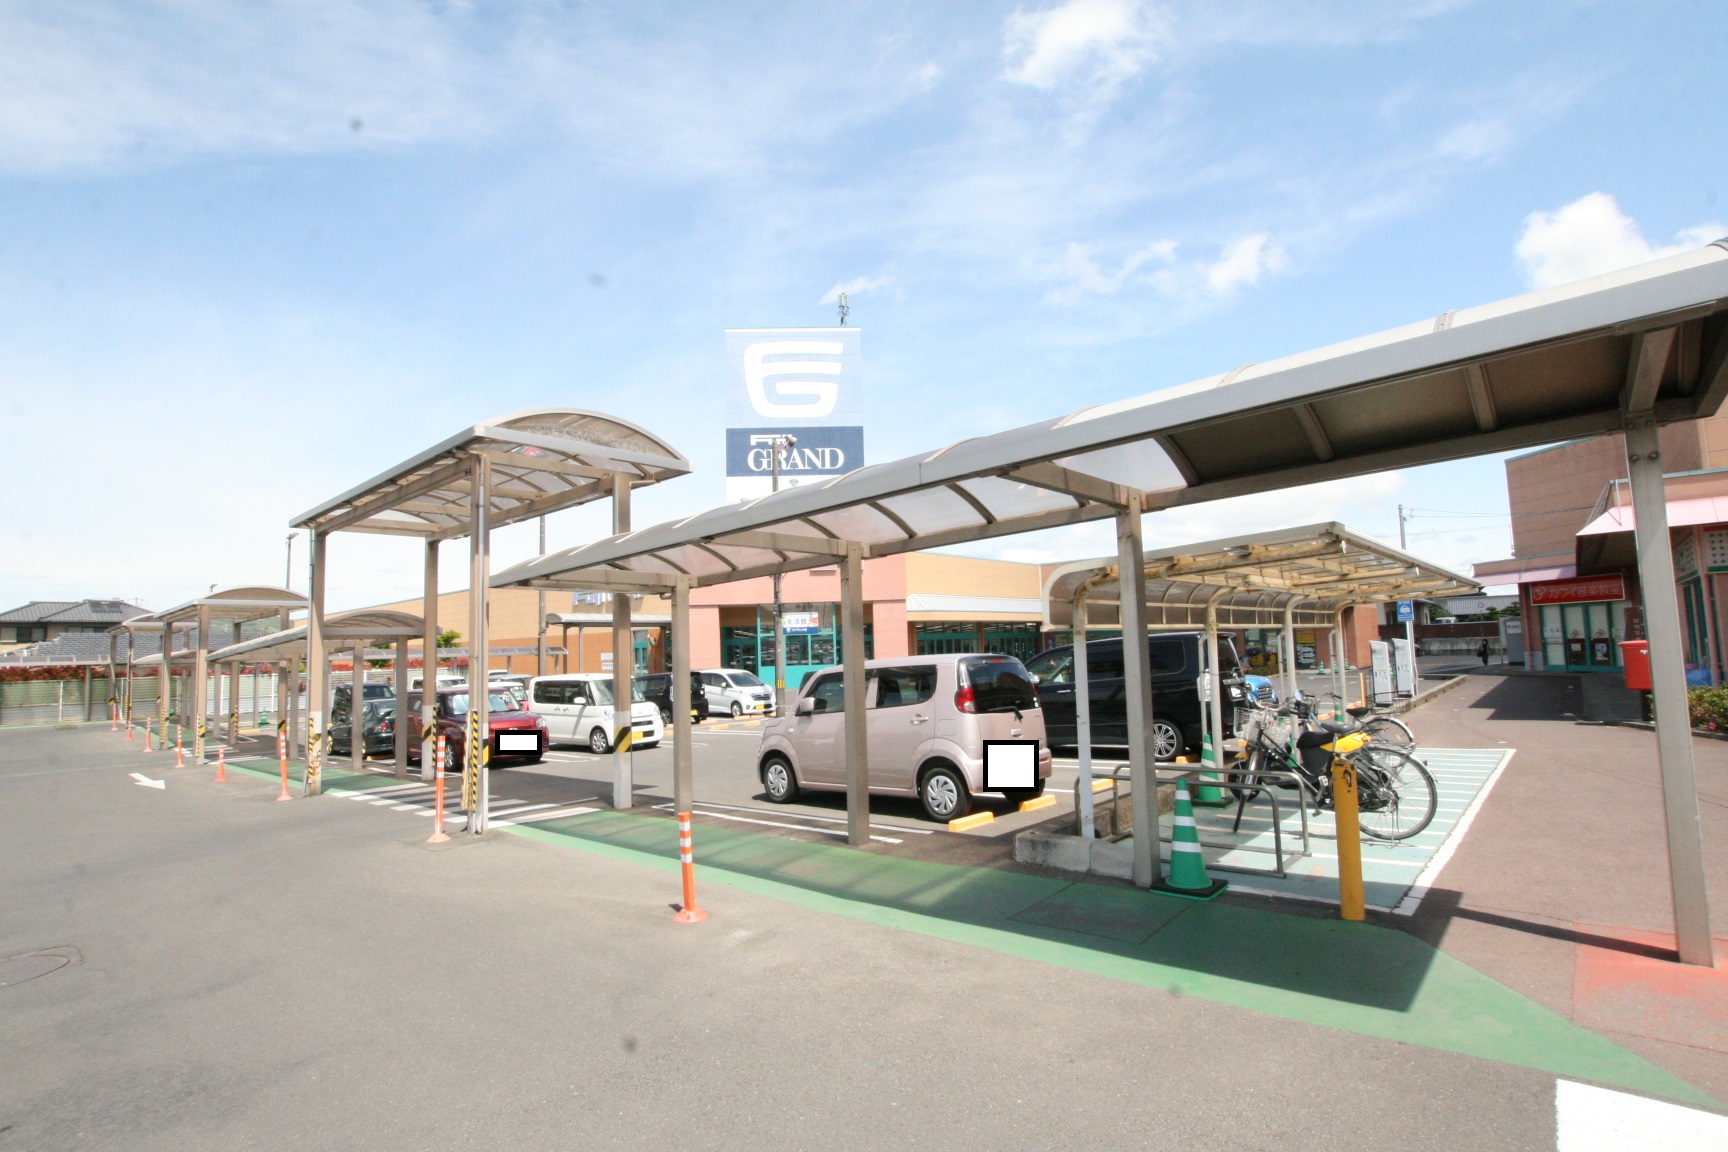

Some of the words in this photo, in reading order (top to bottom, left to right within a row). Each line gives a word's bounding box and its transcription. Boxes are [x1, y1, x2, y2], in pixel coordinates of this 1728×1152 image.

[747, 447, 844, 472] GRAND
[1548, 583, 1621, 599] カワイ音楽教室
